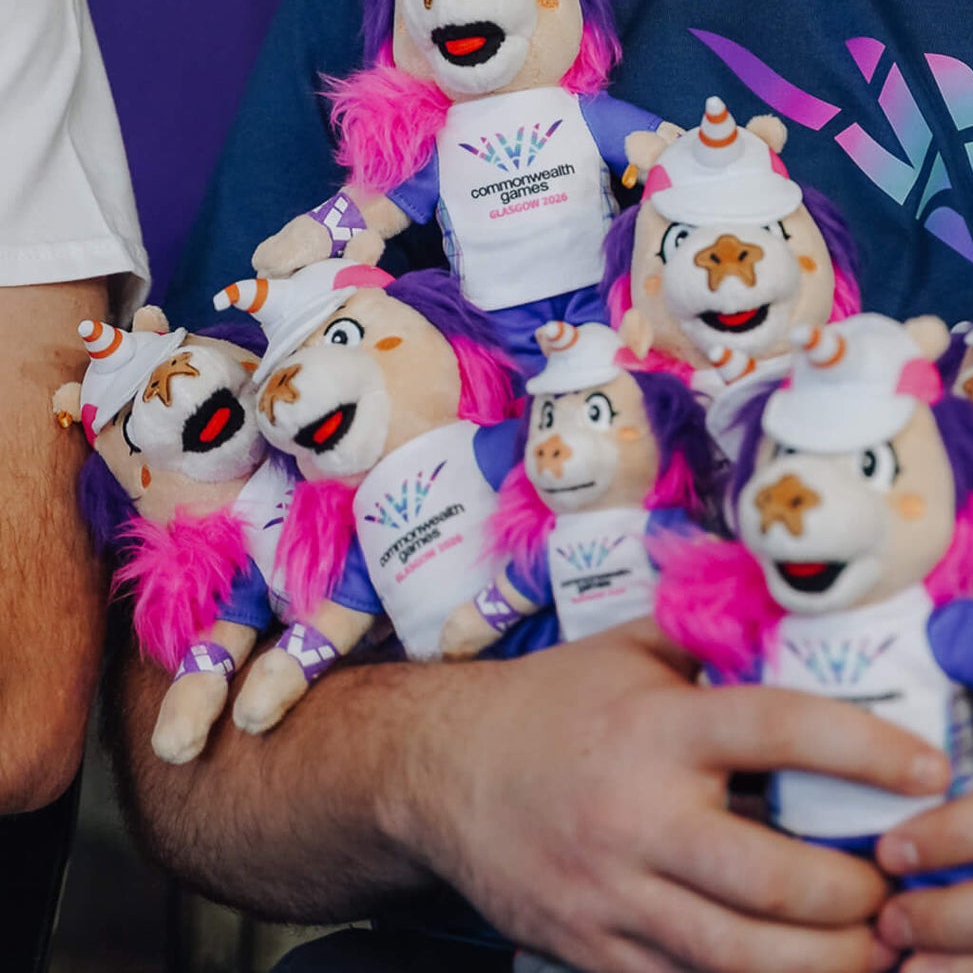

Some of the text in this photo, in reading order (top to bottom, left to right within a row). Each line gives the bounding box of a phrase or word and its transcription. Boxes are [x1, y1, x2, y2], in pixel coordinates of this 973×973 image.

[471, 163, 575, 199] commonwealth
[500, 181, 549, 205] games
[489, 192, 568, 219] GLASGOW 2026
[380, 504, 465, 567] commonwealth
[399, 528, 440, 565] games
